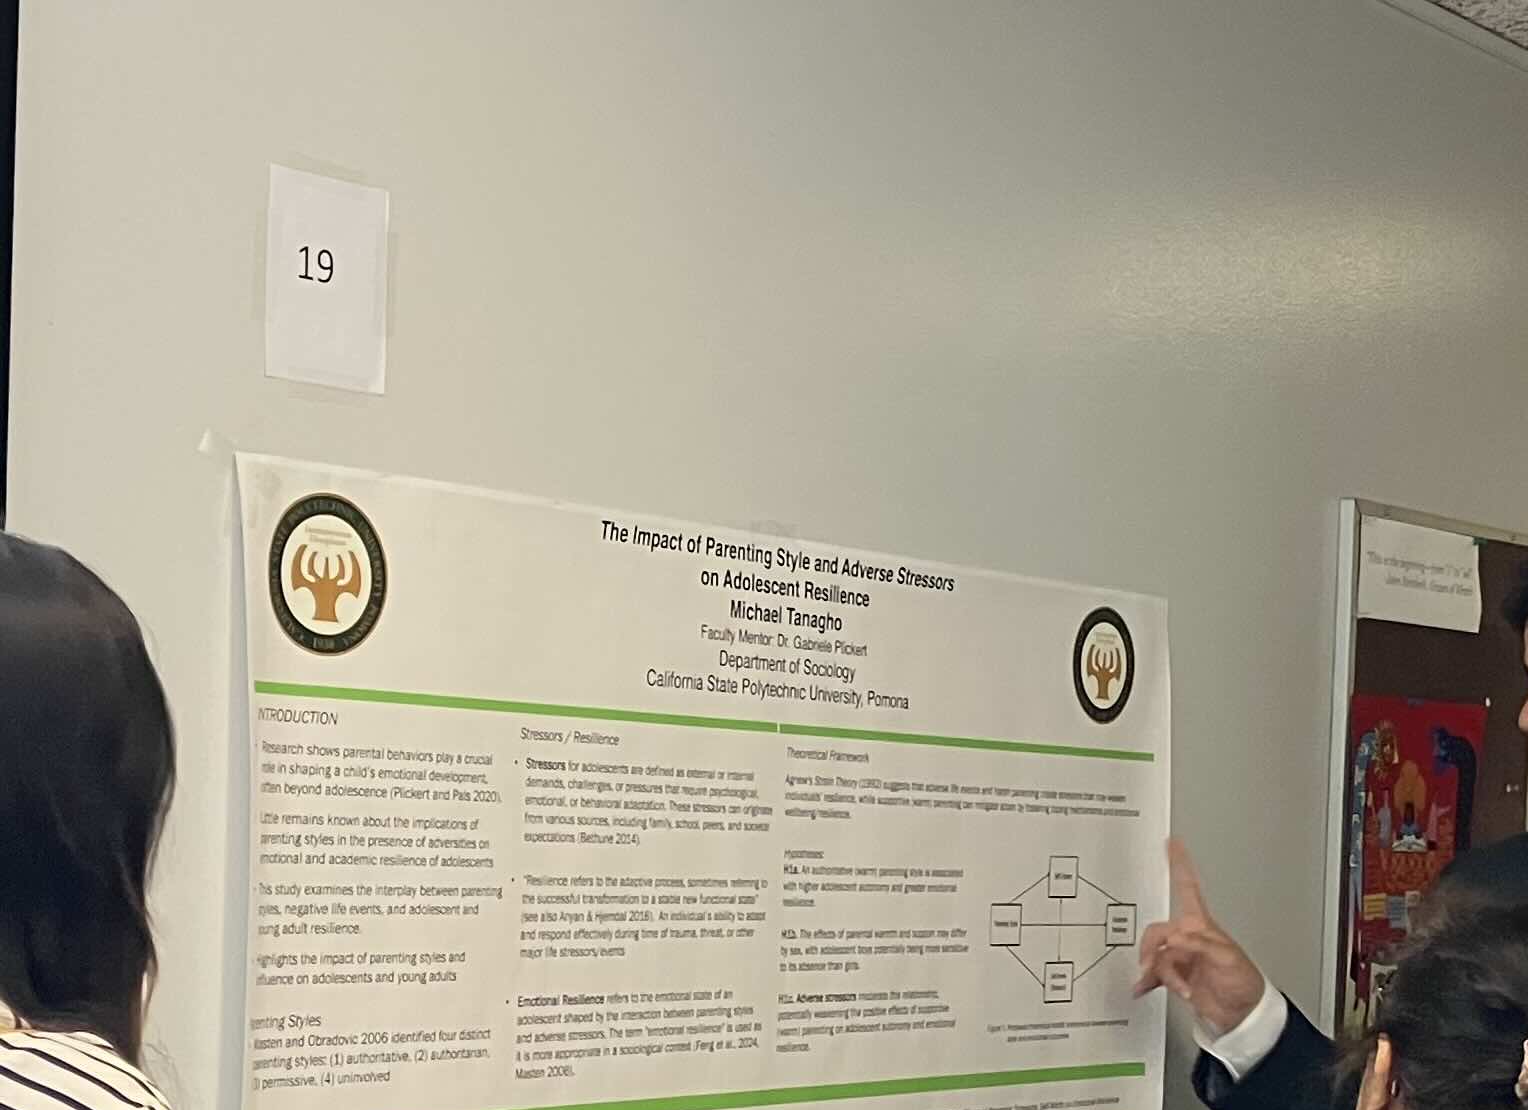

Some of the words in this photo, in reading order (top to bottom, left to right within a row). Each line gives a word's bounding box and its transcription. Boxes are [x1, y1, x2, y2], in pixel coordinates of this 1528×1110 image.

[298, 246, 334, 283] 19
[602, 520, 628, 542] The
[633, 525, 682, 552] Impact
[687, 535, 703, 553] of
[706, 537, 772, 569] Parenting
[777, 548, 810, 573] Style
[815, 557, 838, 574] and
[842, 559, 893, 583] Adverse
[898, 567, 955, 592] Stressors
[701, 570, 719, 587] on
[724, 570, 800, 598] Adolescent
[805, 582, 870, 607] Resilience
[730, 600, 782, 624] Michael
[787, 607, 842, 634] Tanagho
[701, 624, 735, 646] Faculty
[777, 634, 788, 647] Dr.
[793, 635, 832, 653] Gabriele
[835, 640, 868, 657] Plickert
[720, 650, 786, 672] Department
[789, 659, 801, 673] of
[803, 659, 856, 683] Sociology
[647, 669, 703, 690] California
[707, 674, 737, 694] State
[742, 678, 806, 700] Polytechnic
[809, 684, 864, 708] University,
[867, 690, 909, 709] Pomona
[258, 708, 338, 725] NTRODUCTION
[520, 728, 563, 742] Stressors
[574, 732, 619, 746] Resilience
[306, 744, 340, 758] shows
[343, 747, 384, 760] parental
[387, 749, 433, 763] behaviors
[436, 751, 454, 765] play
[278, 763, 286, 774] in
[289, 763, 331, 778] shaping
[334, 767, 341, 777] a
[378, 769, 426, 781] emotional
[526, 758, 566, 772] Stressors
[284, 783, 321, 797] beyond
[325, 784, 387, 798] adolescence
[432, 788, 450, 801] and
[282, 813, 324, 826] remains
[327, 814, 360, 826] known
[362, 815, 391, 828] about
[394, 816, 409, 828] the
[304, 833, 334, 848] styles
[337, 834, 346, 846] in
[350, 834, 365, 847] the
[368, 836, 413, 849] presence
[416, 836, 425, 848] of
[305, 852, 325, 865] and
[328, 854, 377, 865] academic
[275, 883, 301, 897] study
[304, 884, 353, 896] examines
[356, 883, 372, 896] the
[419, 885, 458, 897] between
[285, 904, 328, 919] negative
[387, 905, 406, 915] and
[282, 923, 307, 935] adult
[300, 952, 317, 965] the
[320, 952, 354, 967] impact
[357, 952, 367, 965] of
[370, 953, 417, 967] parenting
[448, 951, 466, 963] and
[296, 972, 309, 985] on
[312, 972, 373, 984] adolescents
[375, 971, 394, 983] and
[398, 971, 426, 984] young
[288, 1013, 321, 1029] Styles
[285, 1036, 305, 1048] and
[360, 1032, 388, 1045] 2006
[391, 1031, 436, 1044] identified
[439, 1030, 457, 1042] four
[330, 1054, 344, 1067] (1)
[415, 1050, 428, 1062] (2)
[321, 1071, 334, 1086] (4)
